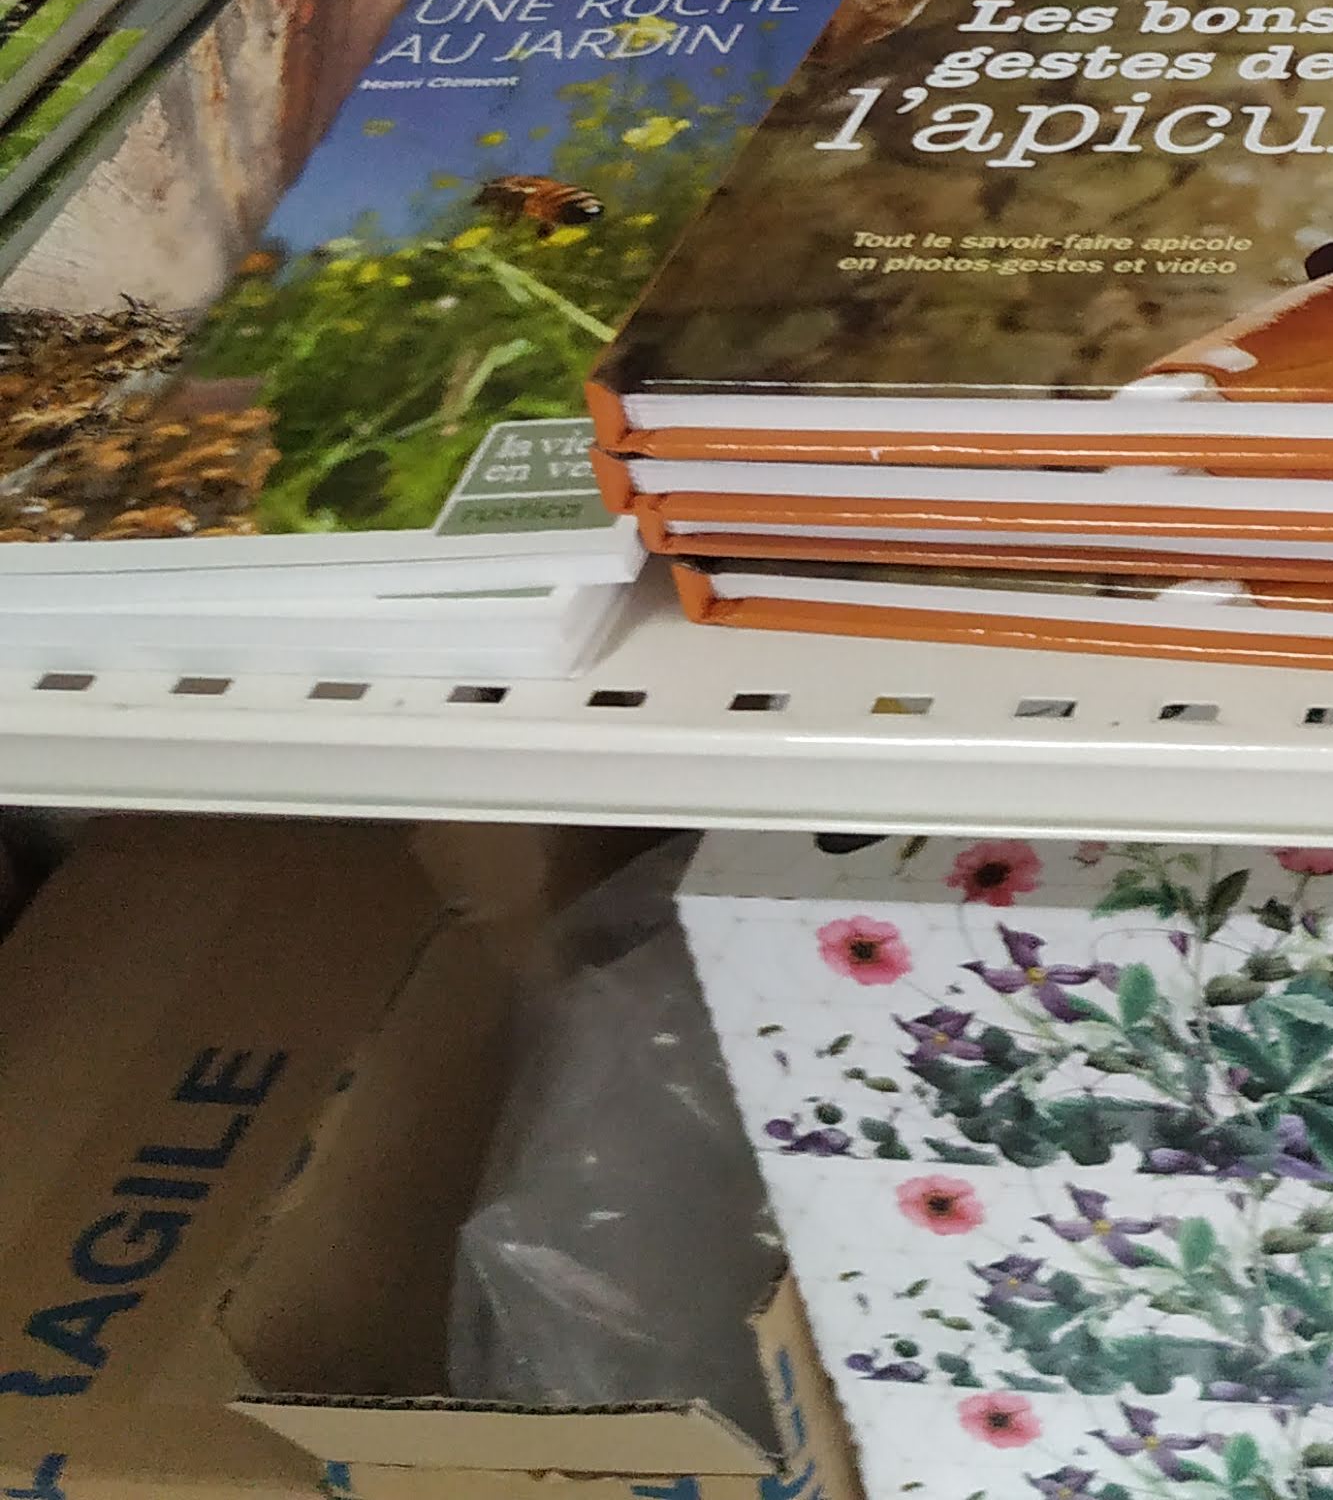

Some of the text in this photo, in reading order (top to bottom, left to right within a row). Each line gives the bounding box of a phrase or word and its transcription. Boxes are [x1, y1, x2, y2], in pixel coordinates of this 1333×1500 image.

[376, 24, 744, 66] AU JARDIN
[926, 46, 1226, 88] gestes
[853, 231, 1254, 254] Tout le savoir-faire apicole
[837, 255, 1238, 276] en photos-gestes et vidéo
[0, 1046, 289, 1397] AGILE
